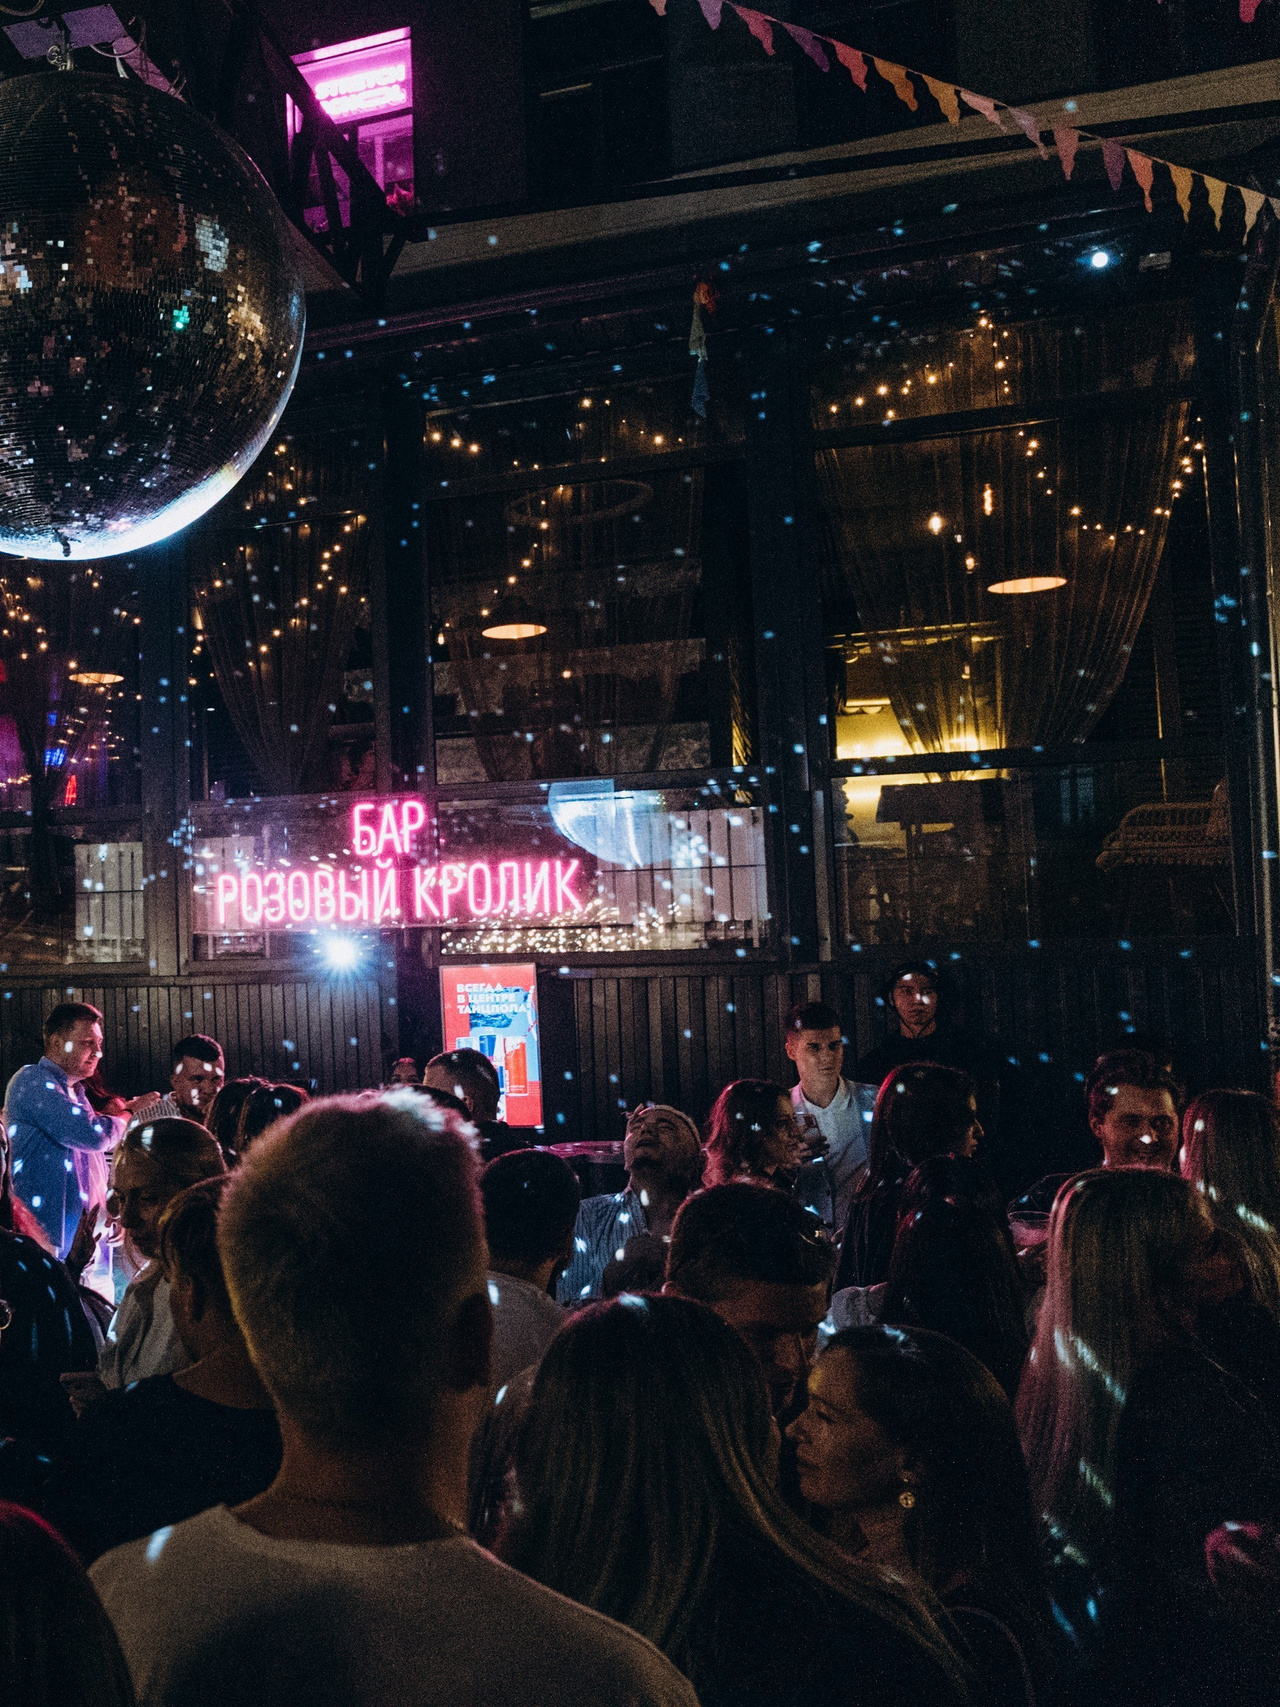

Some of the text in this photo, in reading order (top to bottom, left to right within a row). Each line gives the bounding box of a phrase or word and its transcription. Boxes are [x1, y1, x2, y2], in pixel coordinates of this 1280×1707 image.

[352, 800, 426, 856] БАР
[217, 857, 583, 924] РОЗОВЫЙ КРОЛИК
[456, 982, 504, 993] ВСЕГДА
[457, 993, 516, 1004] В ЦЕНТРЕ
